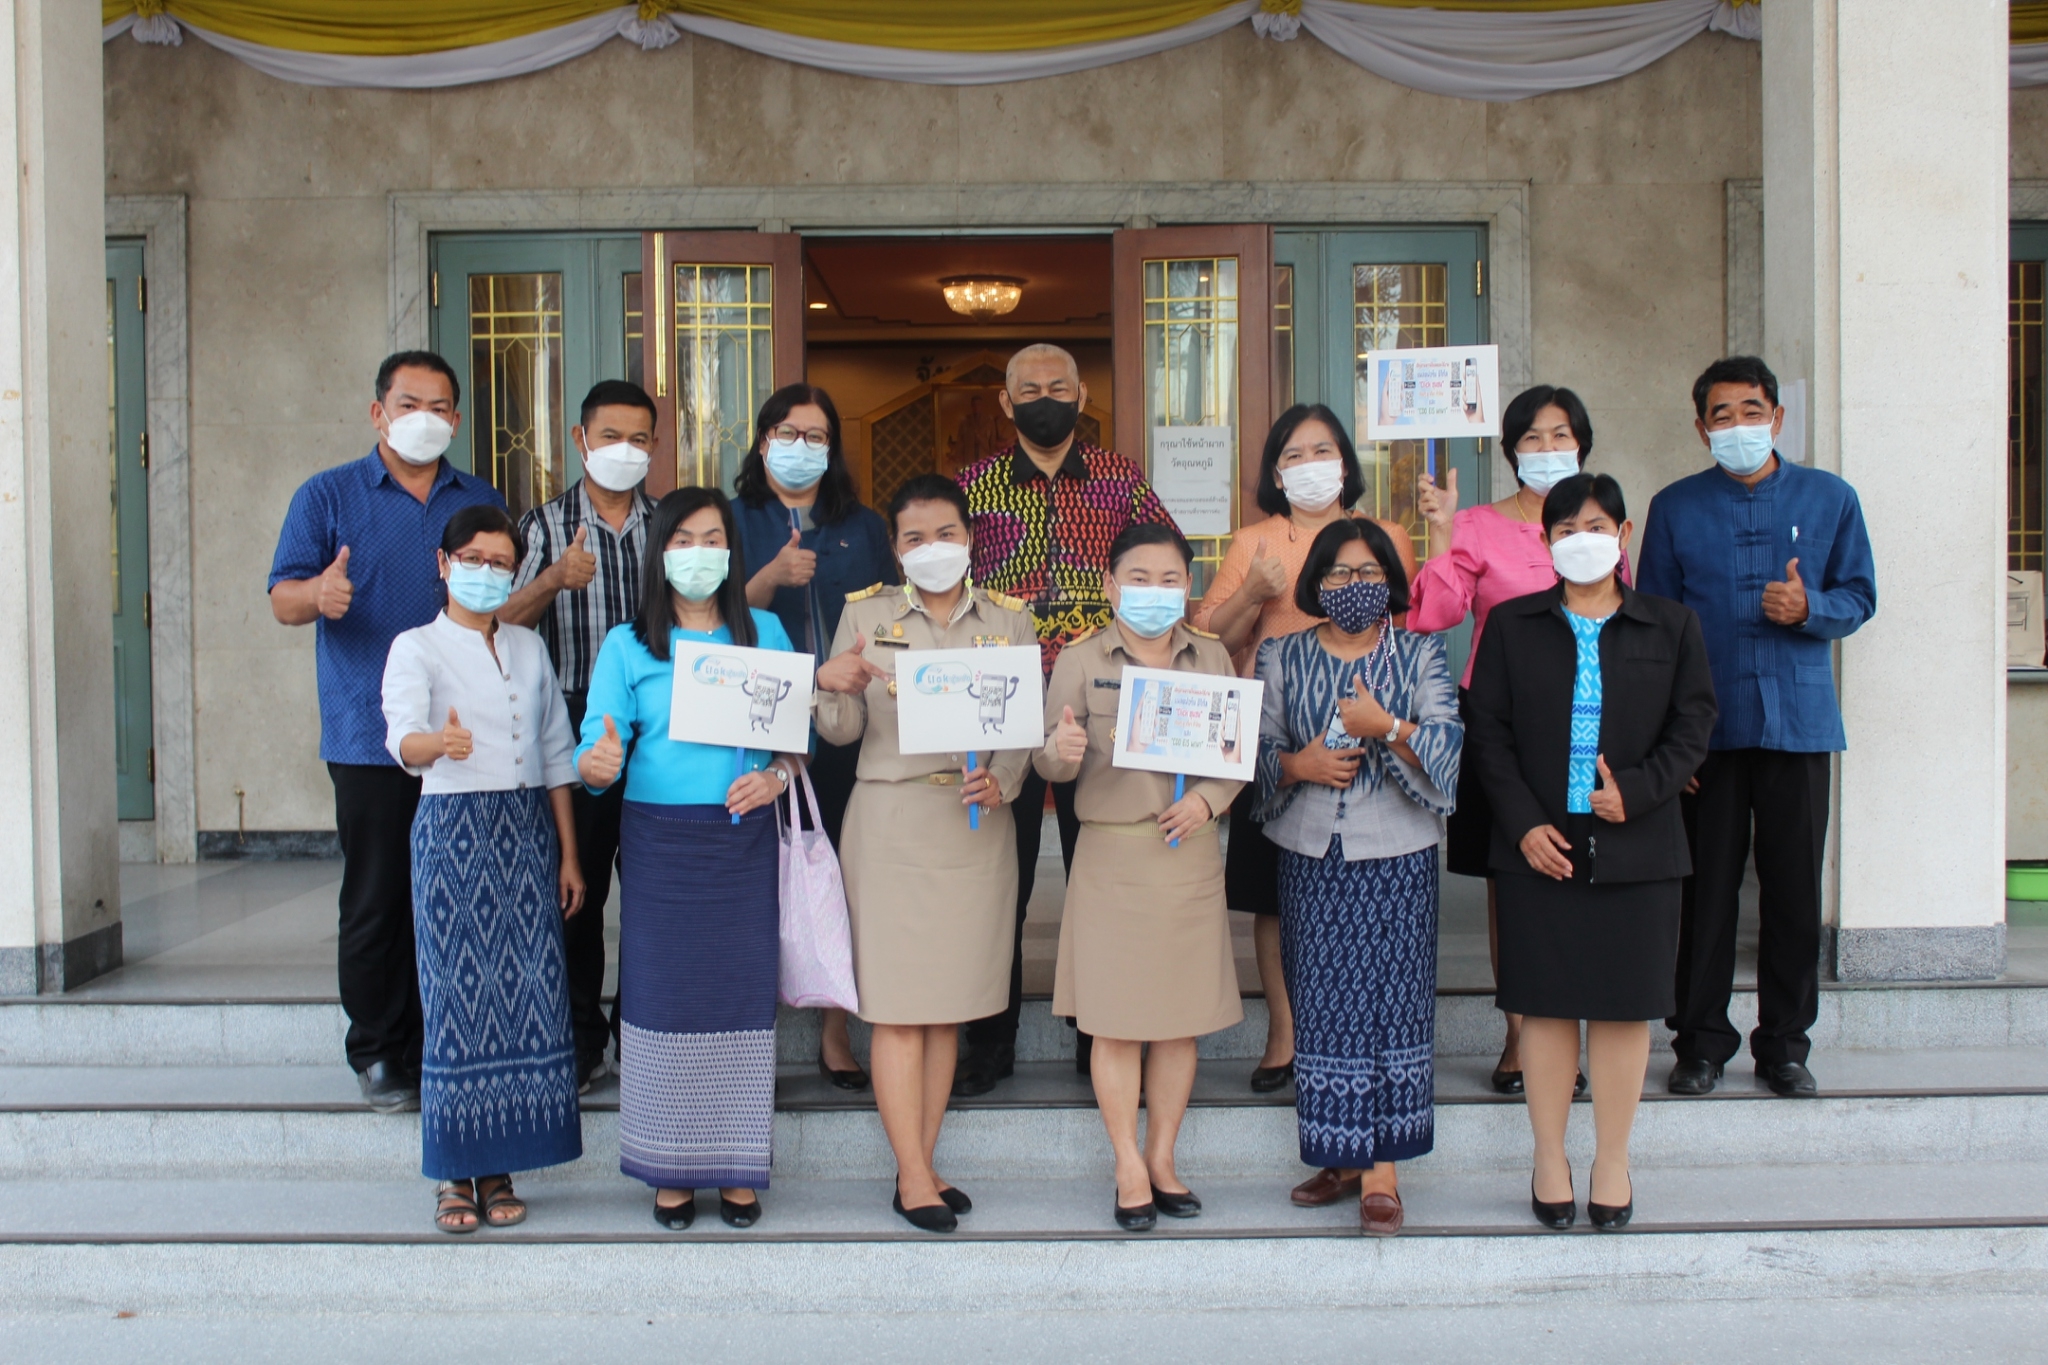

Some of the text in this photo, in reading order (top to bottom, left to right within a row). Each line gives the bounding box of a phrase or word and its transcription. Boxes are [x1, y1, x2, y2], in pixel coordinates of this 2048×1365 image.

[1160, 438, 1224, 451] กรุณาใช้หน้าผาก
[1171, 457, 1213, 471] วัดอุณหภูมิ
